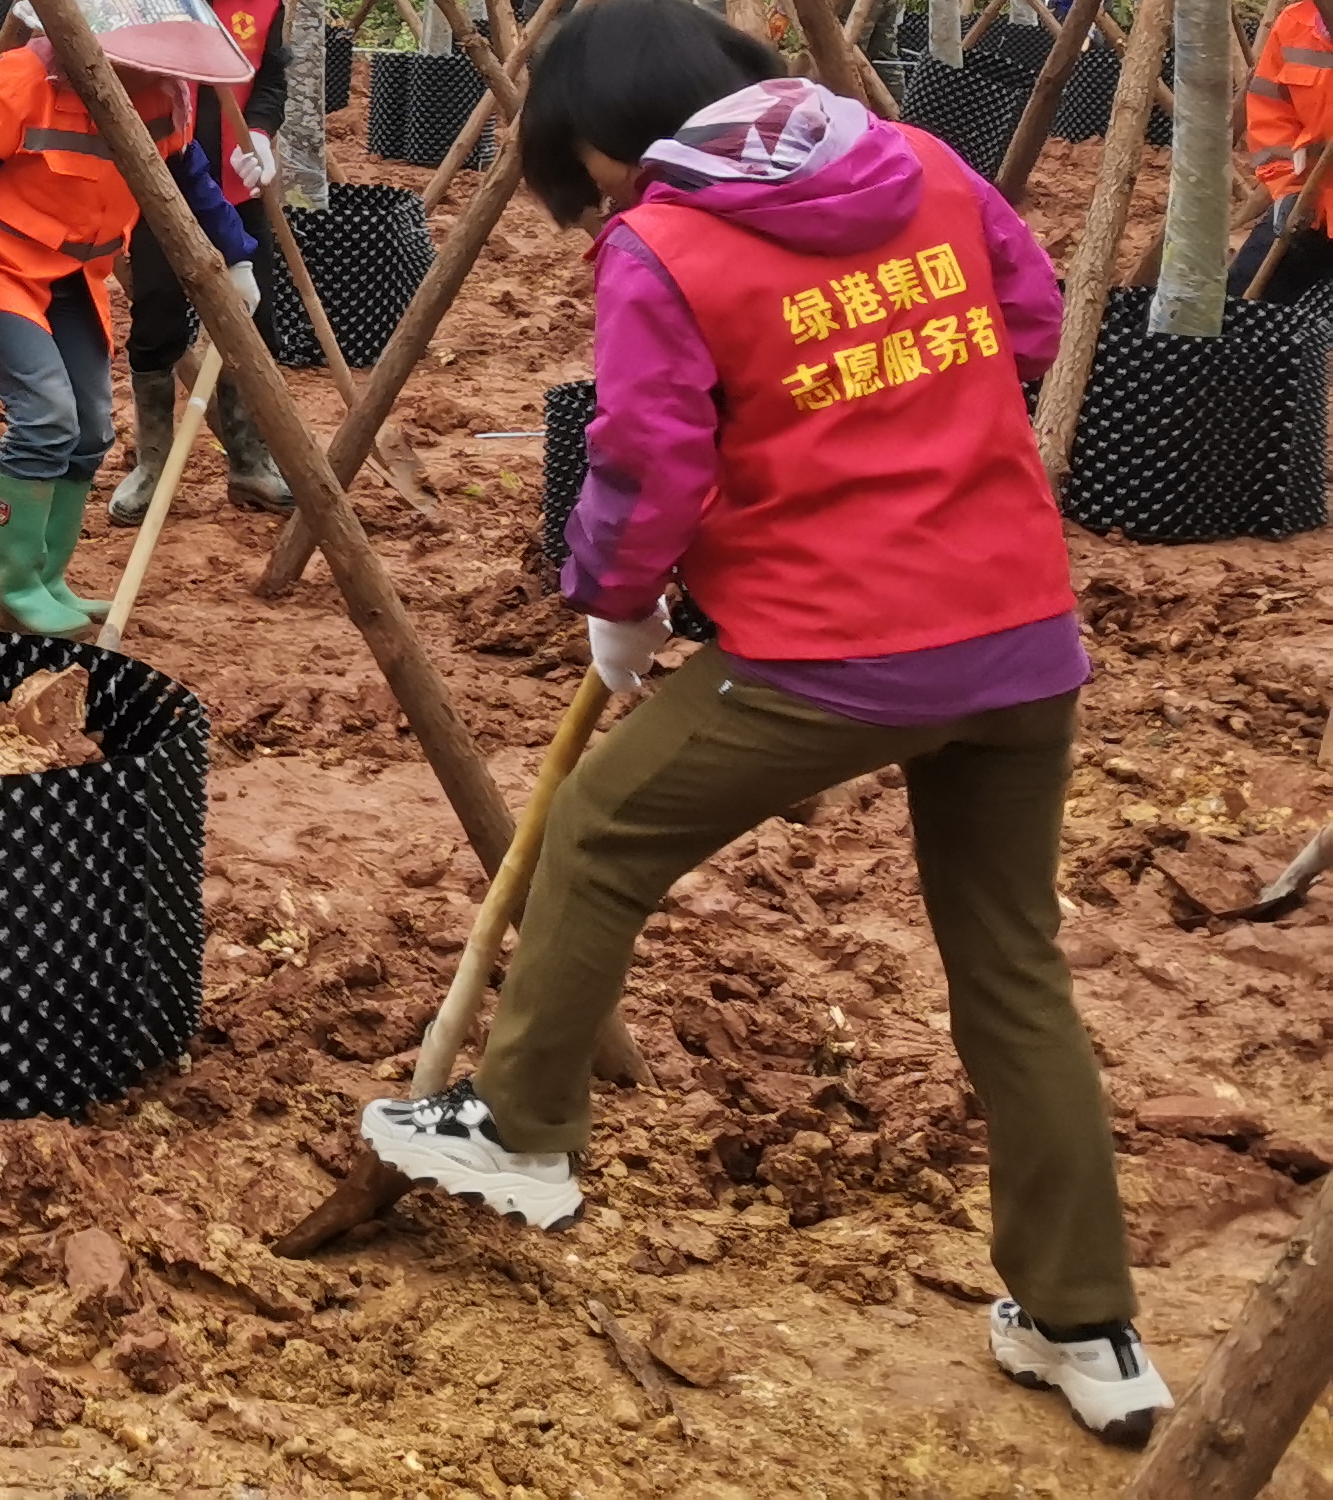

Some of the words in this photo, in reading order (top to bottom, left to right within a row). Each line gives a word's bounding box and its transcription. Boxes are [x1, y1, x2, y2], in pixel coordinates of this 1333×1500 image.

[782, 243, 967, 345] 绿港集团
[781, 306, 1000, 411] 志愿服务者
